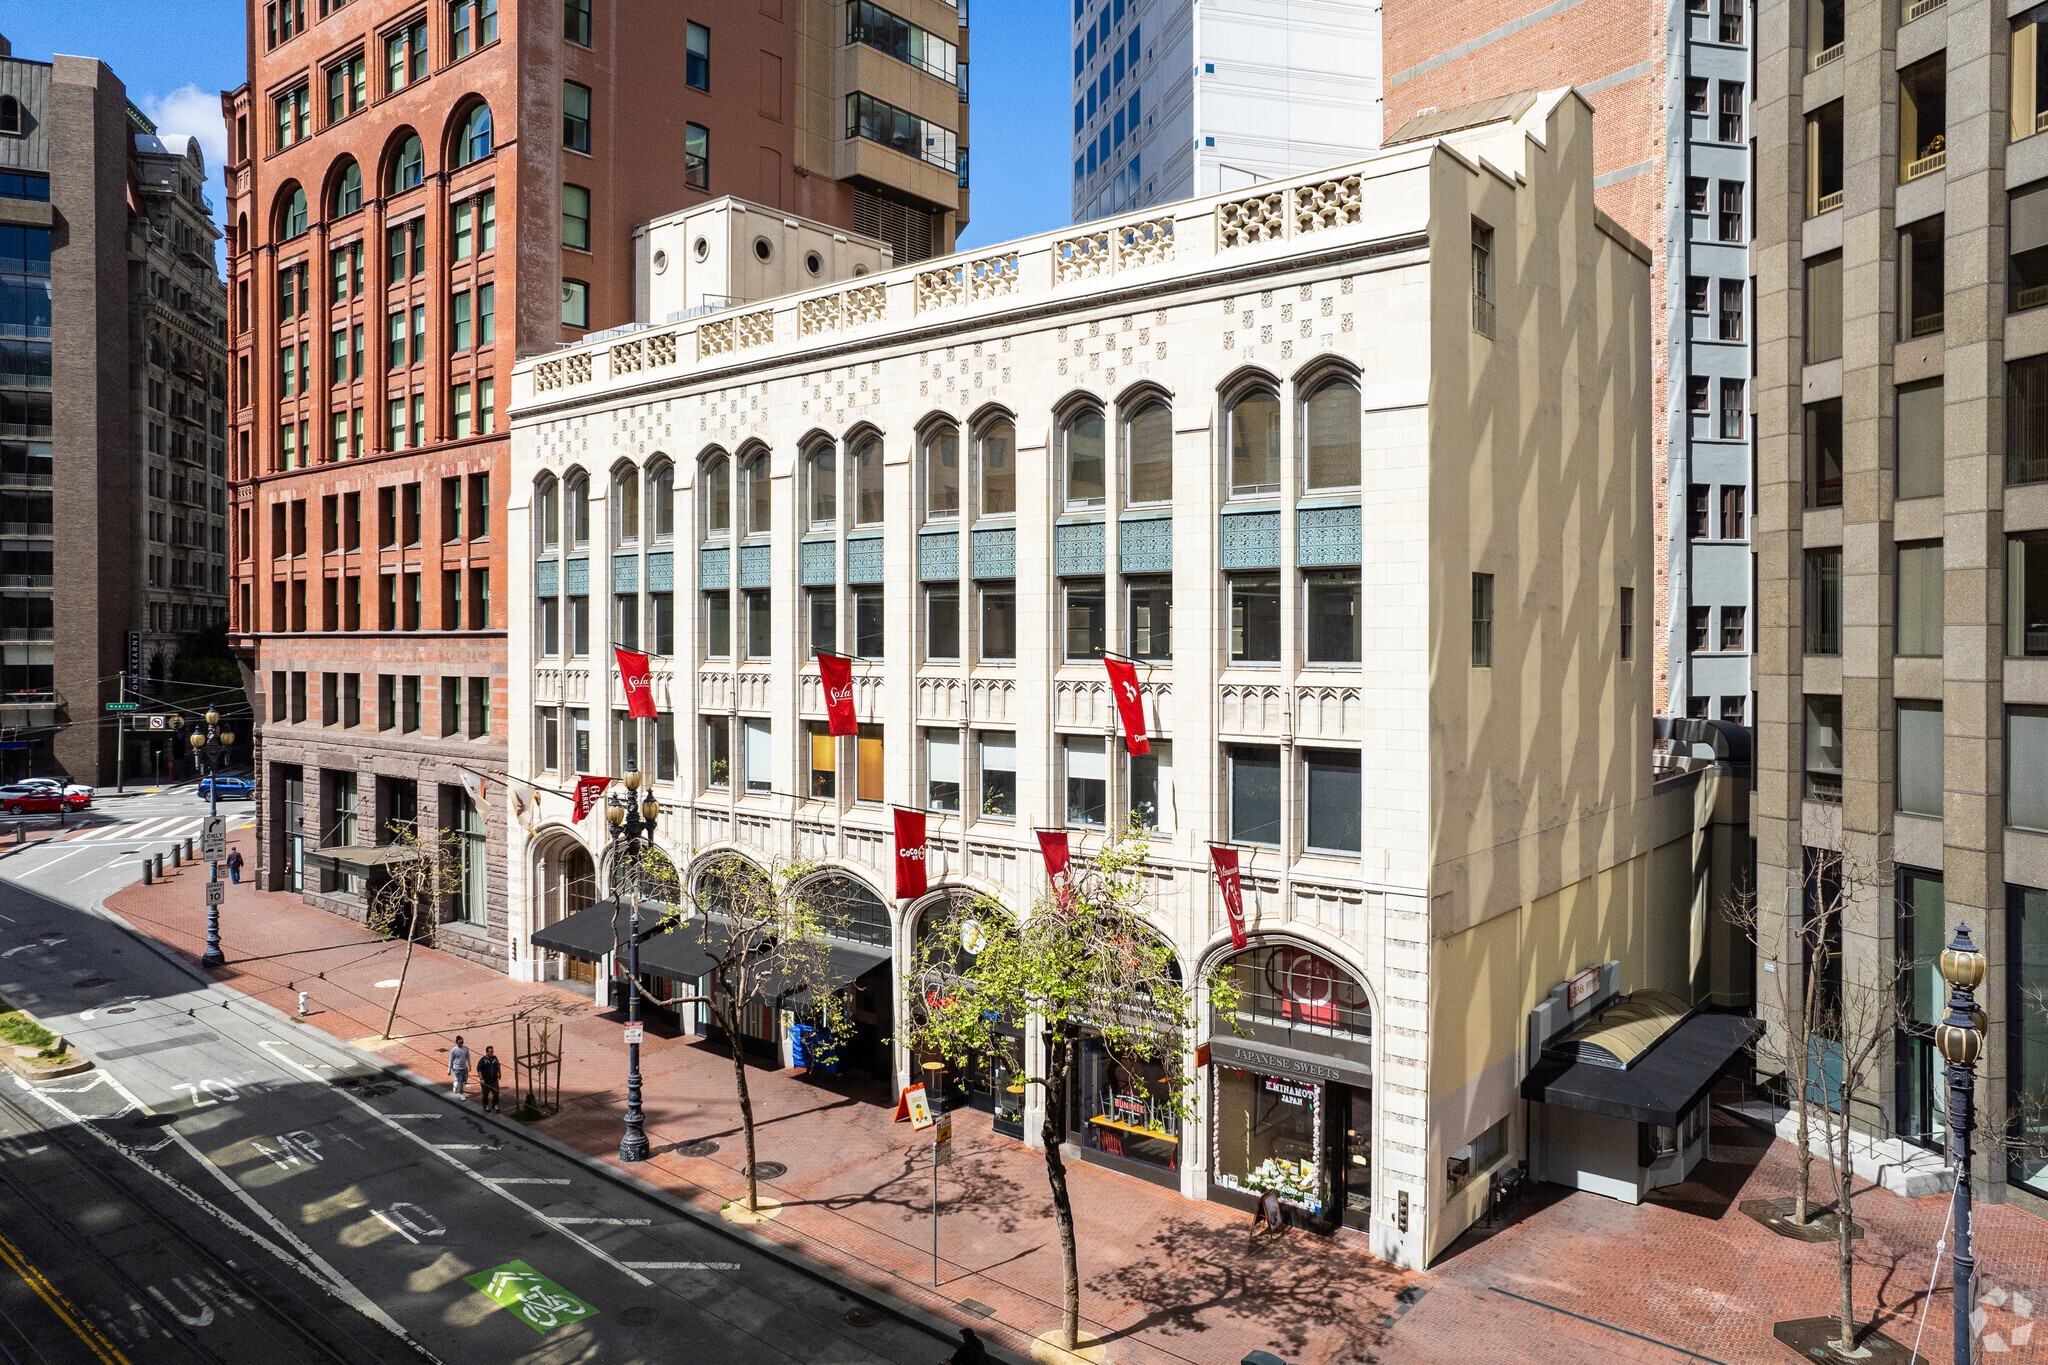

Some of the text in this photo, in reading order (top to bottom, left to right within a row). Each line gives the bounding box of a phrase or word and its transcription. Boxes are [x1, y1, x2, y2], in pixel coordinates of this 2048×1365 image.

[131, 634, 139, 690] ONE KEARNY
[628, 672, 650, 694] Sola
[830, 681, 852, 708] Sola
[580, 786, 590, 813] MARKET
[206, 832, 223, 840] ONLY
[209, 892, 221, 901] 10
[1235, 1049, 1340, 1080] JAPANESE SWEETS
[1281, 1094, 1303, 1106] JAPAN
[368, 1202, 446, 1245] 10
